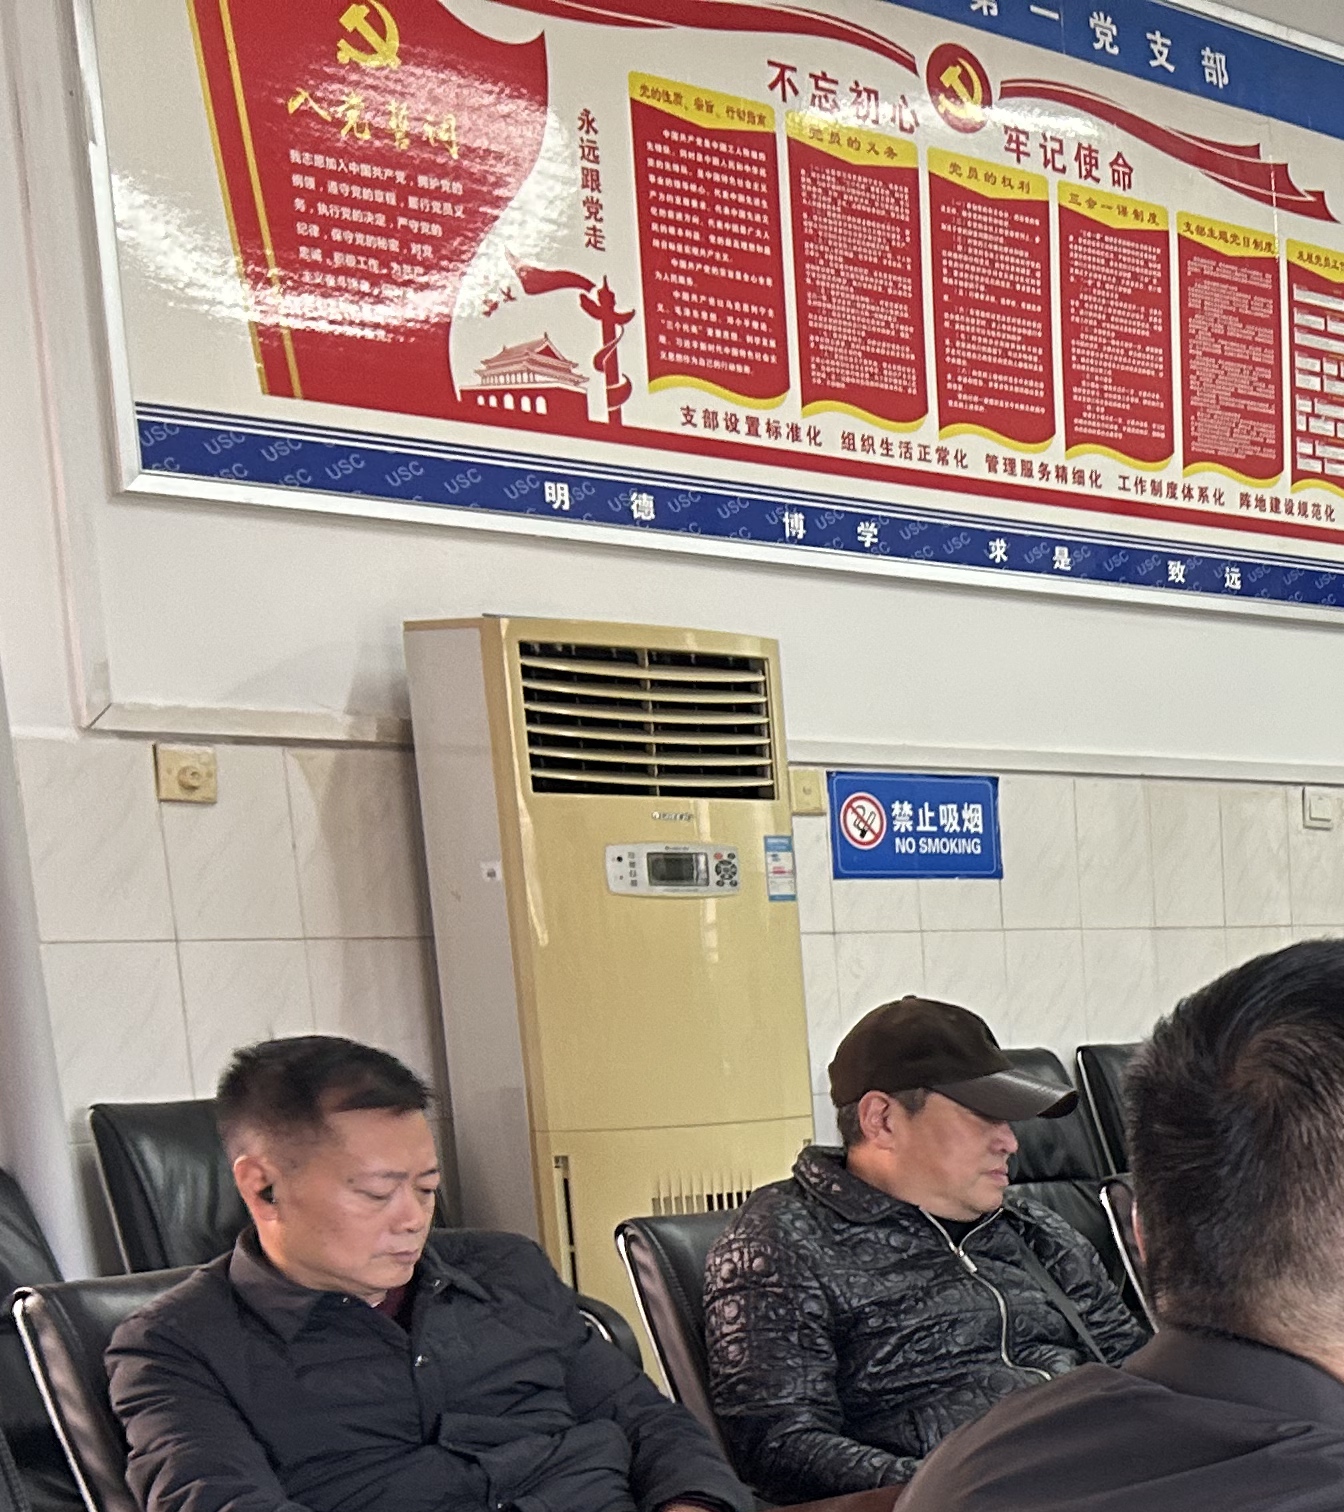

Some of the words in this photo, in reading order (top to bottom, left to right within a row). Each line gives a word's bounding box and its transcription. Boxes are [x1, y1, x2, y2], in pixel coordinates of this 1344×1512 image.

[288, 87, 458, 160] 入党誓词
[767, 59, 920, 134] 不忘初心
[1002, 125, 1134, 192] 牢记使命
[808, 126, 899, 161] 党员的义务
[576, 107, 606, 253] 永远跟党走
[949, 160, 1031, 194] 党员的权利
[1068, 191, 1160, 226] 三会一课制度
[1182, 220, 1275, 255] 支部主题党日制度
[140, 423, 180, 447] USC
[204, 431, 246, 455] USC
[262, 439, 302, 462] USC
[326, 453, 366, 480] USC
[385, 461, 424, 487] USC
[680, 405, 823, 448] 支部设置标准化
[841, 430, 969, 469] 组织生活正常化
[985, 453, 1103, 490] 管理服务精细化
[1117, 474, 1226, 507] 工作制度体系化
[1239, 491, 1336, 522] 阵地建设规范化
[444, 468, 482, 494] USC
[503, 474, 540, 499] USC
[667, 491, 701, 513] USC
[717, 498, 749, 519] USC
[815, 509, 845, 530] USC
[900, 519, 928, 540] USC
[942, 532, 972, 554] USC
[1023, 542, 1050, 564] USC
[1104, 551, 1129, 572] USC
[1136, 555, 1162, 576] USC
[1248, 565, 1271, 582] USC
[1282, 568, 1305, 585] USC
[1315, 571, 1337, 589] USC
[891, 800, 983, 834] 禁止吸烟
[895, 837, 916, 854] NO
[919, 837, 981, 855] SMOKING
